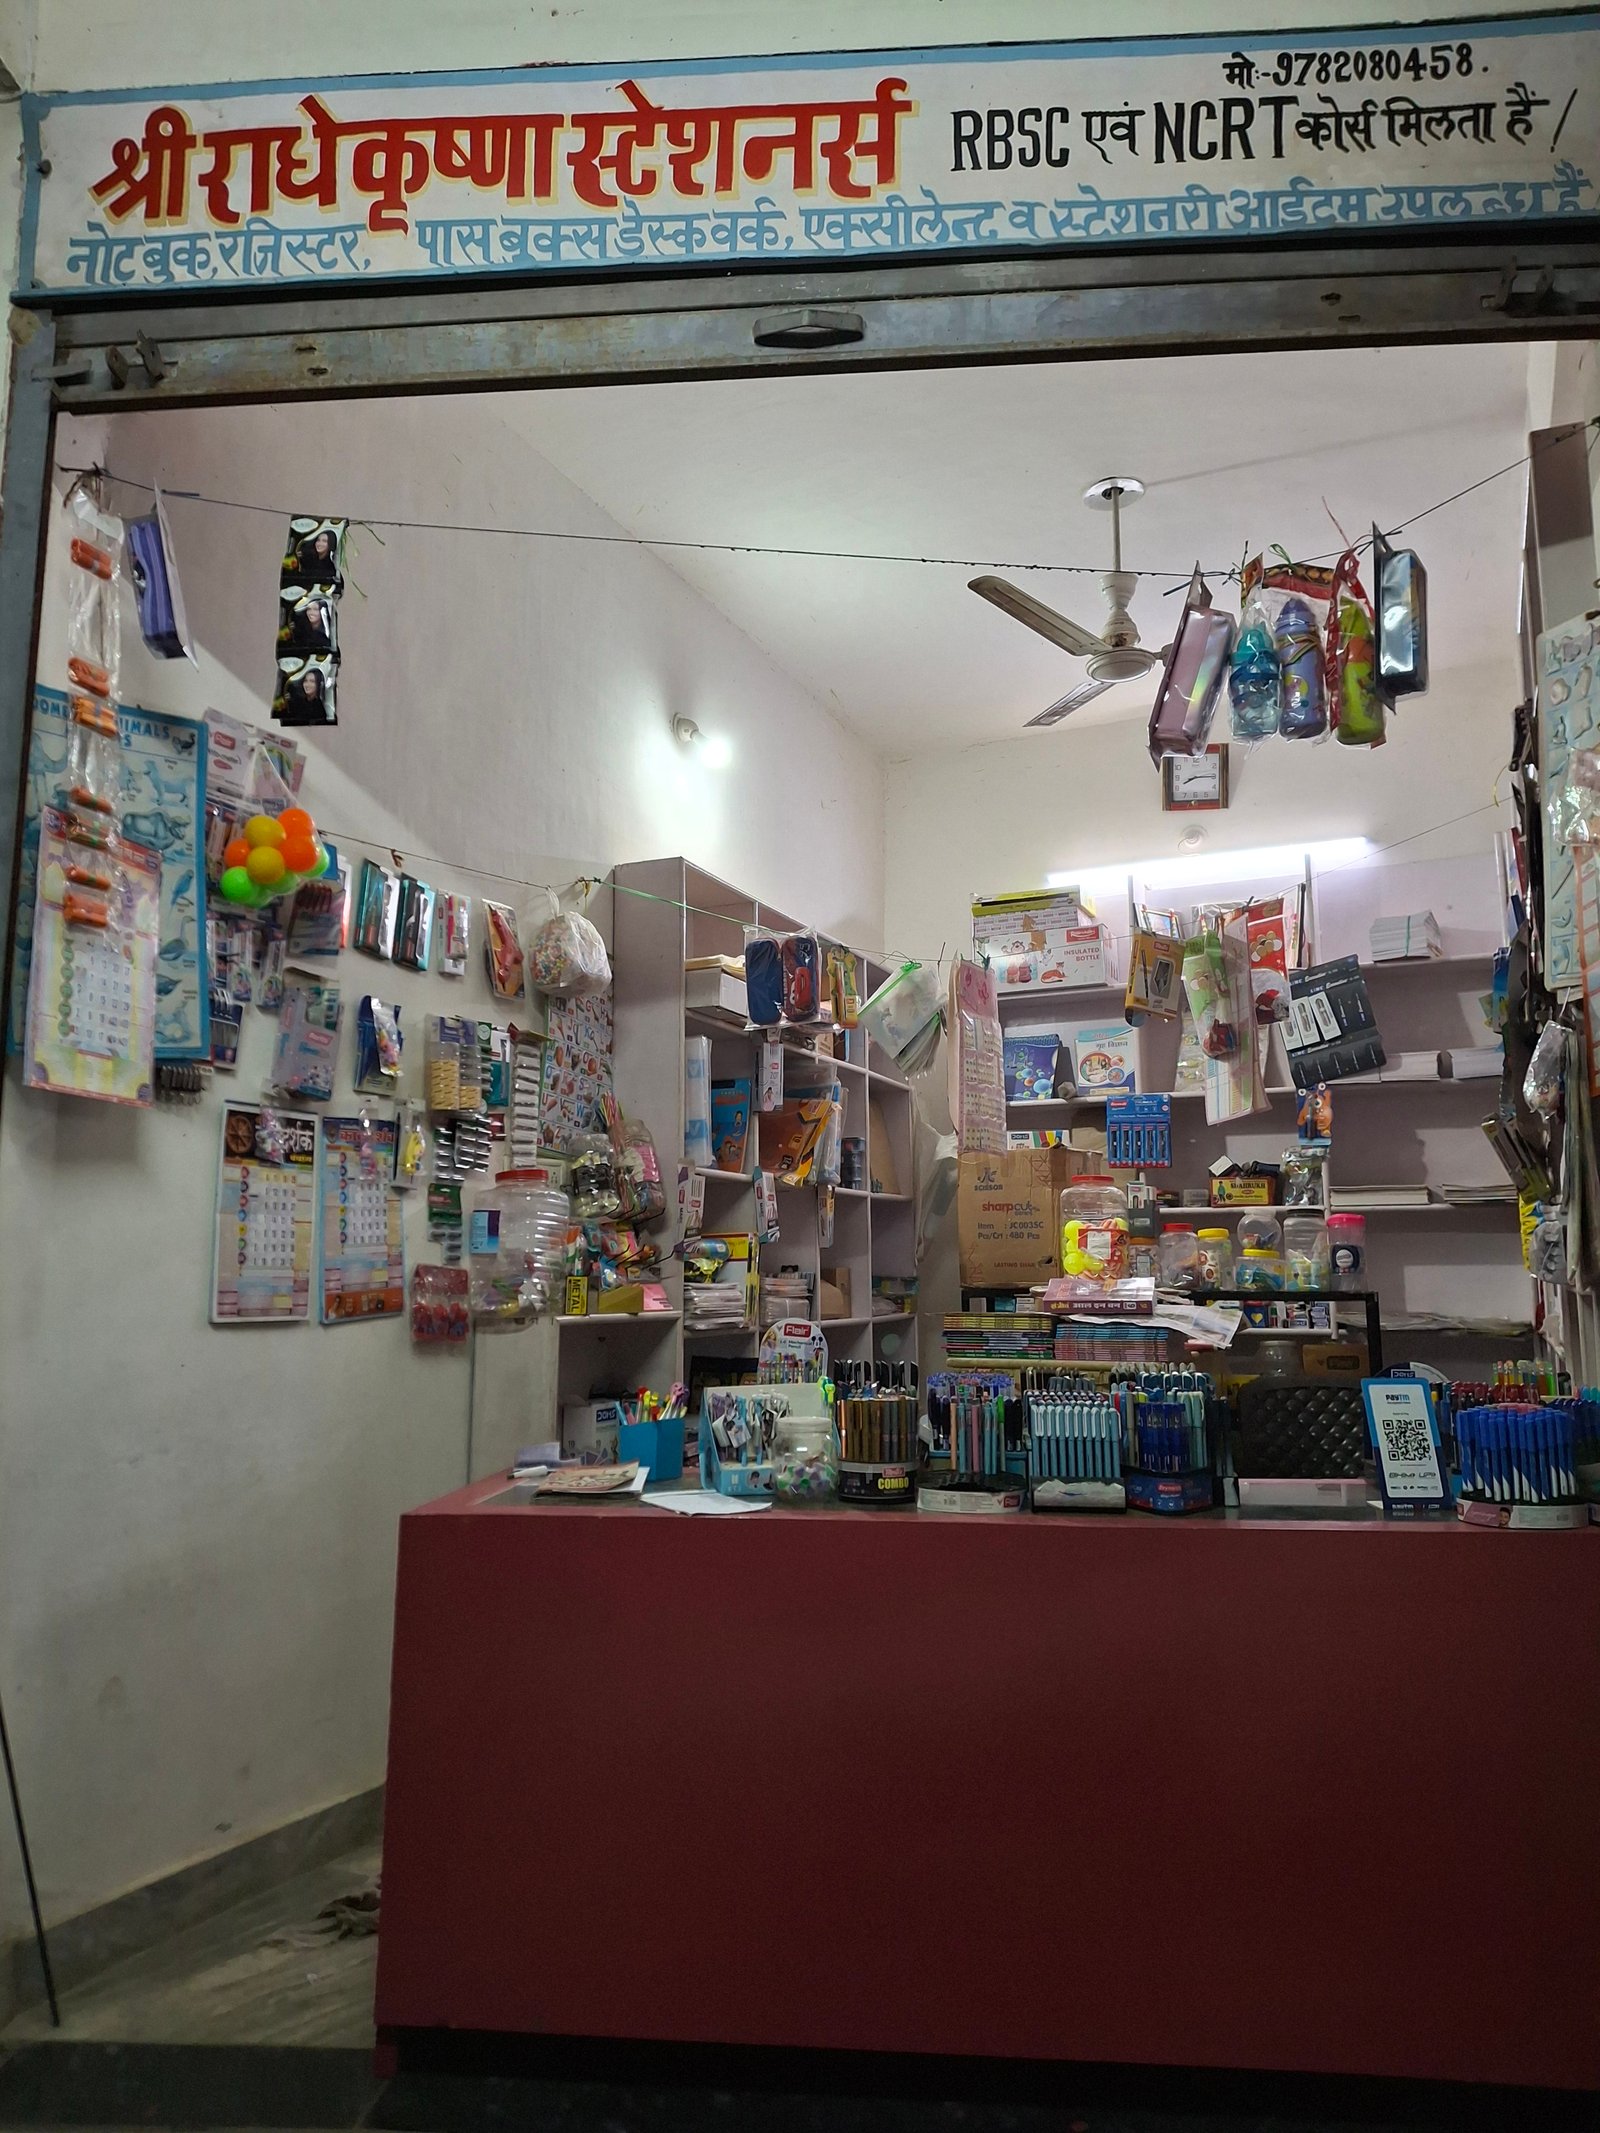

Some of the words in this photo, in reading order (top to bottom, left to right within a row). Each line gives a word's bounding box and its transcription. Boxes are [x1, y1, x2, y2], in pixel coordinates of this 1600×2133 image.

[951, 106, 1071, 172] RBSC
[1082, 101, 1147, 165] एवं
[1154, 95, 1300, 165] NCRT
[1296, 92, 1382, 153] कोर्स
[1381, 99, 1499, 150] मिलता
[1063, 947, 1100, 956] INSULATED
[572, 1278, 582, 1313] METAL
[786, 1325, 809, 1335] Flair
[877, 1476, 909, 1491] COMBO
